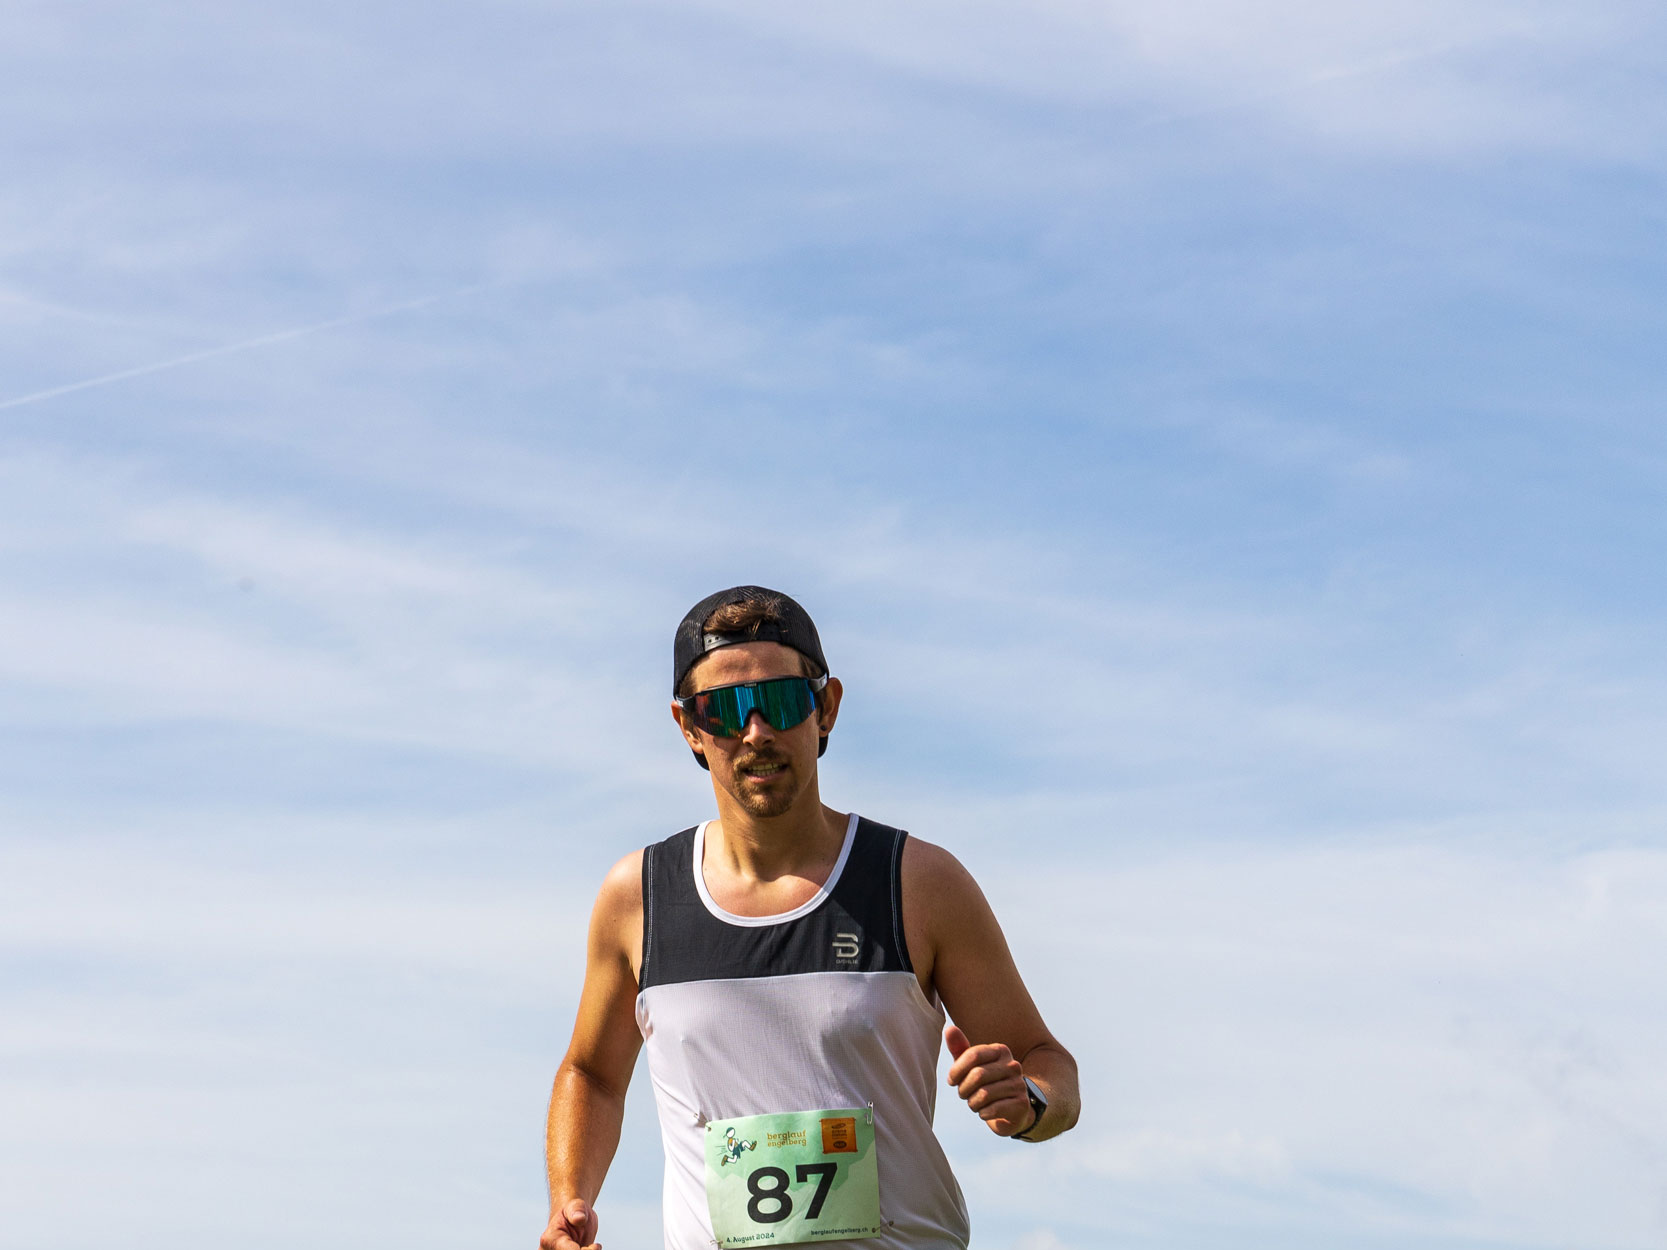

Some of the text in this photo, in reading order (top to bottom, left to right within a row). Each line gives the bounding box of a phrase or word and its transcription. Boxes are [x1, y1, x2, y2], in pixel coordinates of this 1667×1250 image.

[767, 1129, 807, 1141] berglauf
[767, 1139, 807, 1148] engelberg
[747, 1162, 838, 1224] 87
[811, 1226, 869, 1236] berglaufengelberg.ch
[733, 1234, 755, 1244] August
[756, 1232, 775, 1240] 2024
